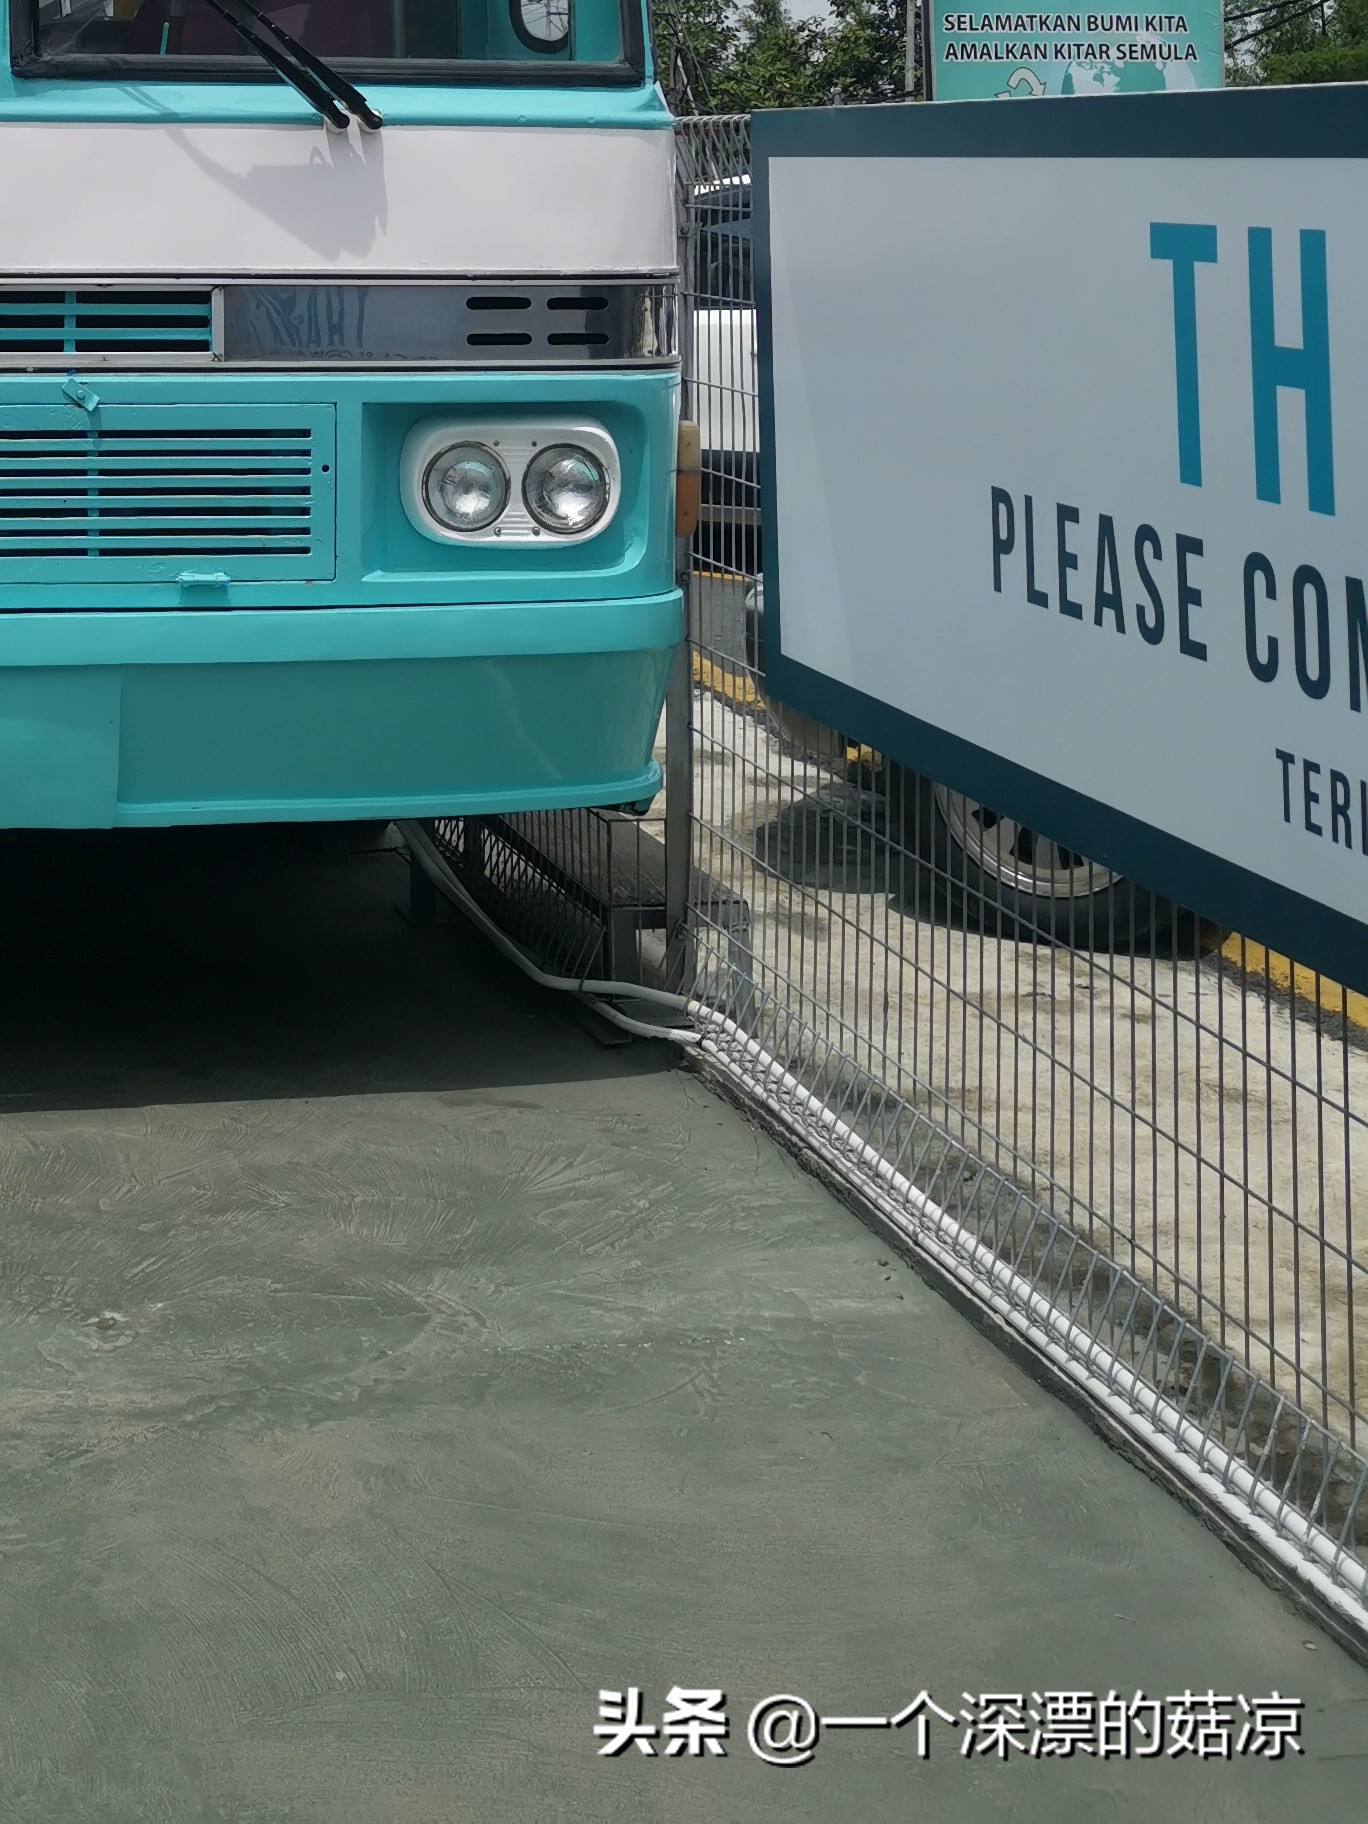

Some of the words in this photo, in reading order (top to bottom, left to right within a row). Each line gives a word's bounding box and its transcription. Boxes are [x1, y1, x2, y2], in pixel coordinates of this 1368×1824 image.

[943, 13, 1081, 32] SELAMATKAN
[1086, 14, 1139, 33] BUMI
[1144, 14, 1188, 33] KITA
[944, 42, 1048, 61] AMALKAN
[1053, 42, 1111, 61] KITAR
[1116, 42, 1198, 61] SEMULA
[991, 485, 1208, 662] PLEASE
